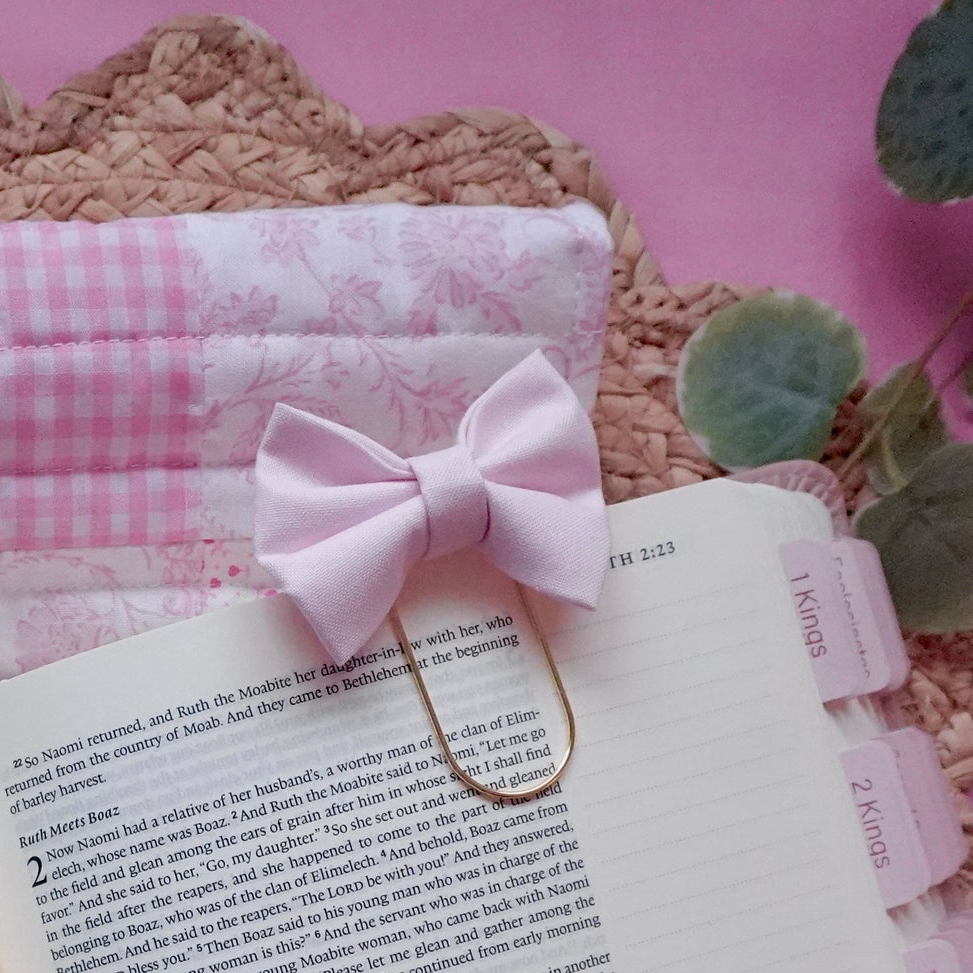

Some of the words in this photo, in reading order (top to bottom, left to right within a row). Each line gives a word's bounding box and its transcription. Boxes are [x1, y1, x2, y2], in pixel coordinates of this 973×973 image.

[640, 541, 676, 561] 2:23
[790, 572, 810, 582] 1
[794, 589, 827, 658] Kings
[4, 768, 53, 797] returned
[55, 760, 87, 778] from
[89, 752, 111, 766] the
[113, 735, 162, 758] country
[165, 726, 180, 742] of
[182, 716, 224, 737] Moab.
[227, 705, 254, 724] And
[257, 699, 285, 715] they
[289, 688, 323, 706] came
[325, 684, 339, 696] to
[342, 655, 413, 691] Bethlehem
[431, 651, 453, 666] the
[454, 634, 520, 659] beginning
[10, 799, 21, 815] of
[21, 789, 57, 810] barley
[57, 774, 107, 797] harvest.
[45, 844, 74, 862] Now
[76, 826, 121, 852] Naomi
[122, 818, 149, 837] had
[150, 818, 160, 828] a
[161, 802, 210, 825] relative
[212, 793, 227, 809] of
[228, 789, 252, 805] her
[326, 766, 335, 777] a
[336, 752, 383, 773] worthy
[387, 743, 417, 760] man
[419, 734, 434, 750] of
[460, 724, 487, 739] clan
[489, 715, 503, 731] of
[505, 710, 540, 727] Elim-
[851, 778, 873, 795] 2
[18, 828, 48, 850] Ruth
[49, 817, 86, 839] Meets
[87, 806, 121, 825] Boaz
[857, 800, 890, 869] Kings
[27, 856, 47, 888] 2
